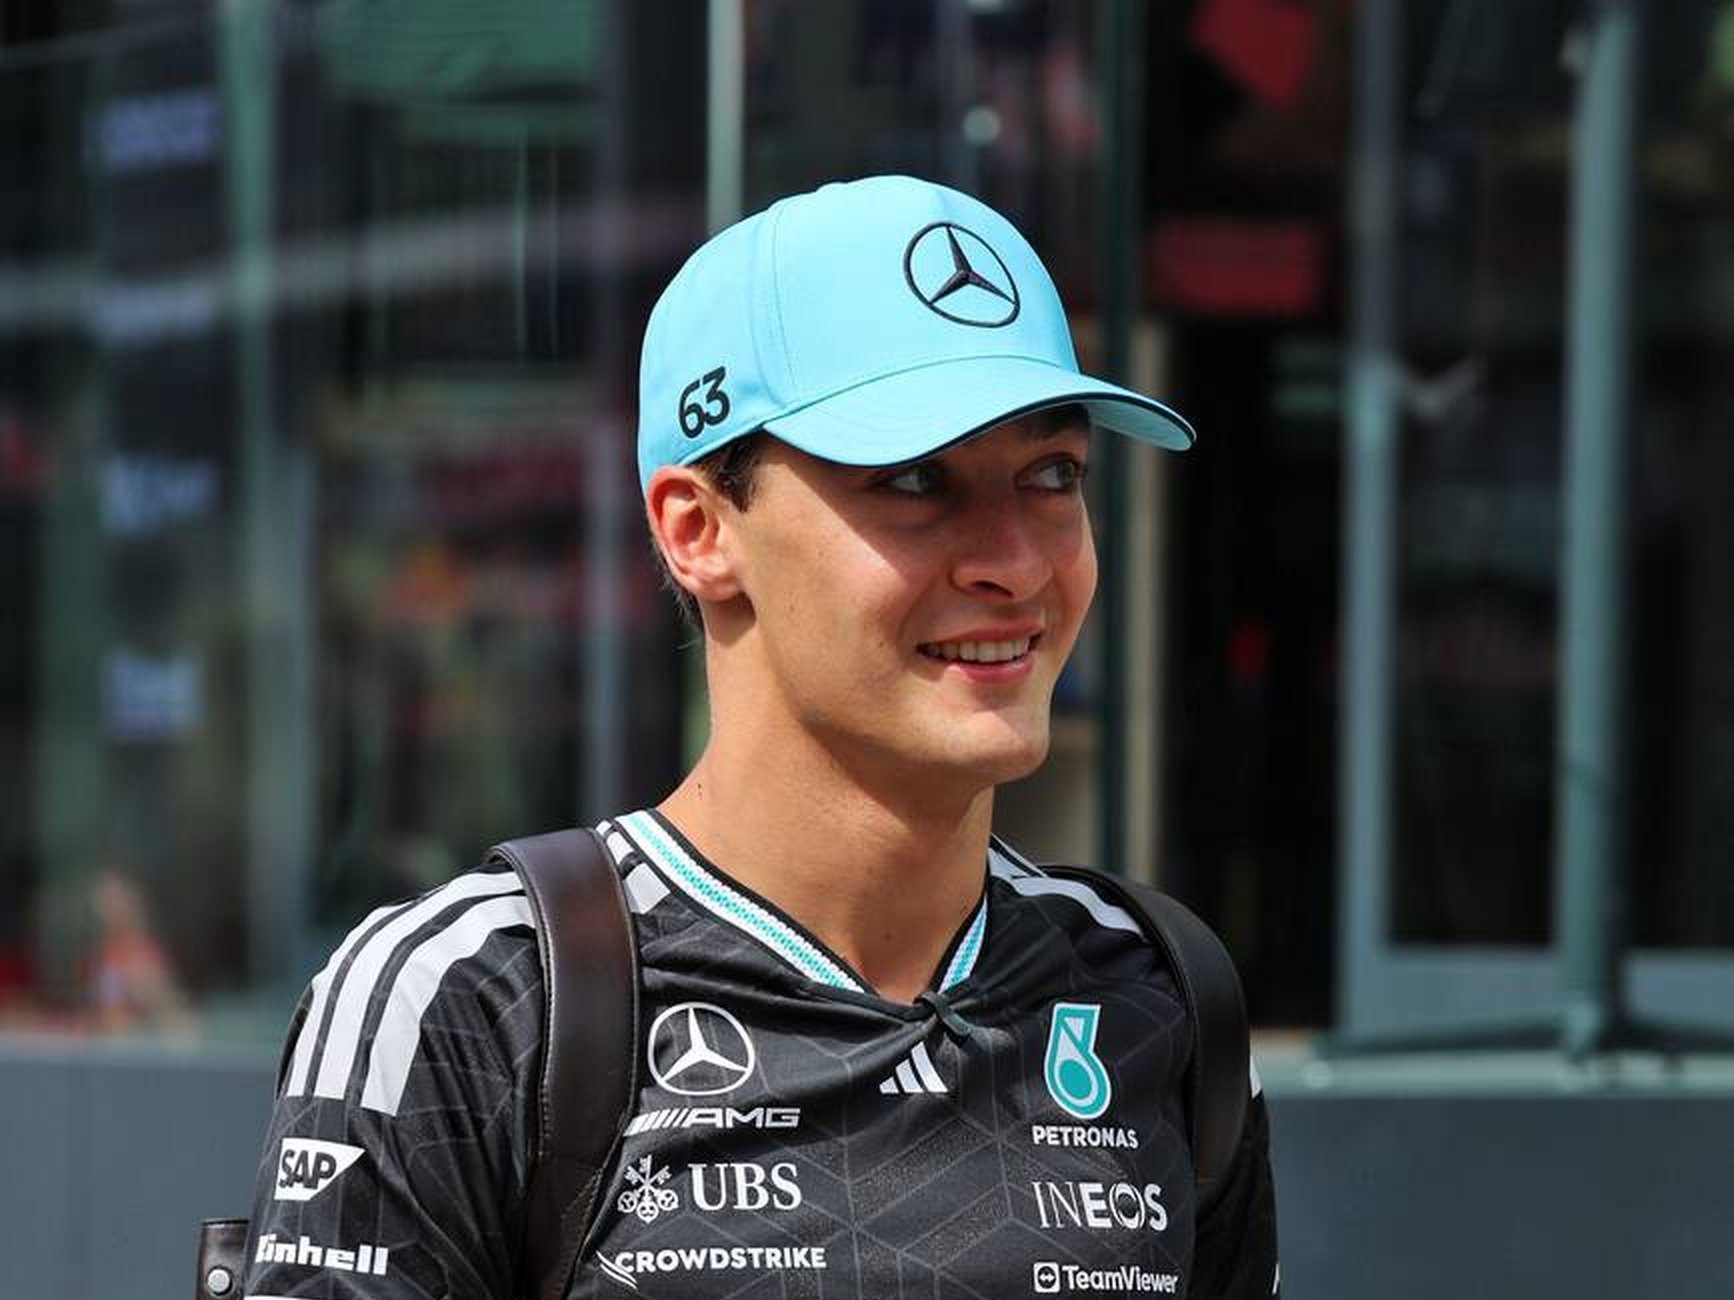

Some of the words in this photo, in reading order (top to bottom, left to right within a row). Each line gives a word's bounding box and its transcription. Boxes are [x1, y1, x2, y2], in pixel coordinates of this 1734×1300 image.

[679, 366, 730, 439] 63
[681, 1107, 800, 1129] AMG
[1032, 1125, 1138, 1149] PETRONAS
[279, 1150, 337, 1190] SAP
[688, 1162, 802, 1211] UBS
[1032, 1181, 1168, 1231] INEOS
[614, 1247, 827, 1273] CROWDSTRIKE
[1062, 1264, 1179, 1293] TeamViewer
